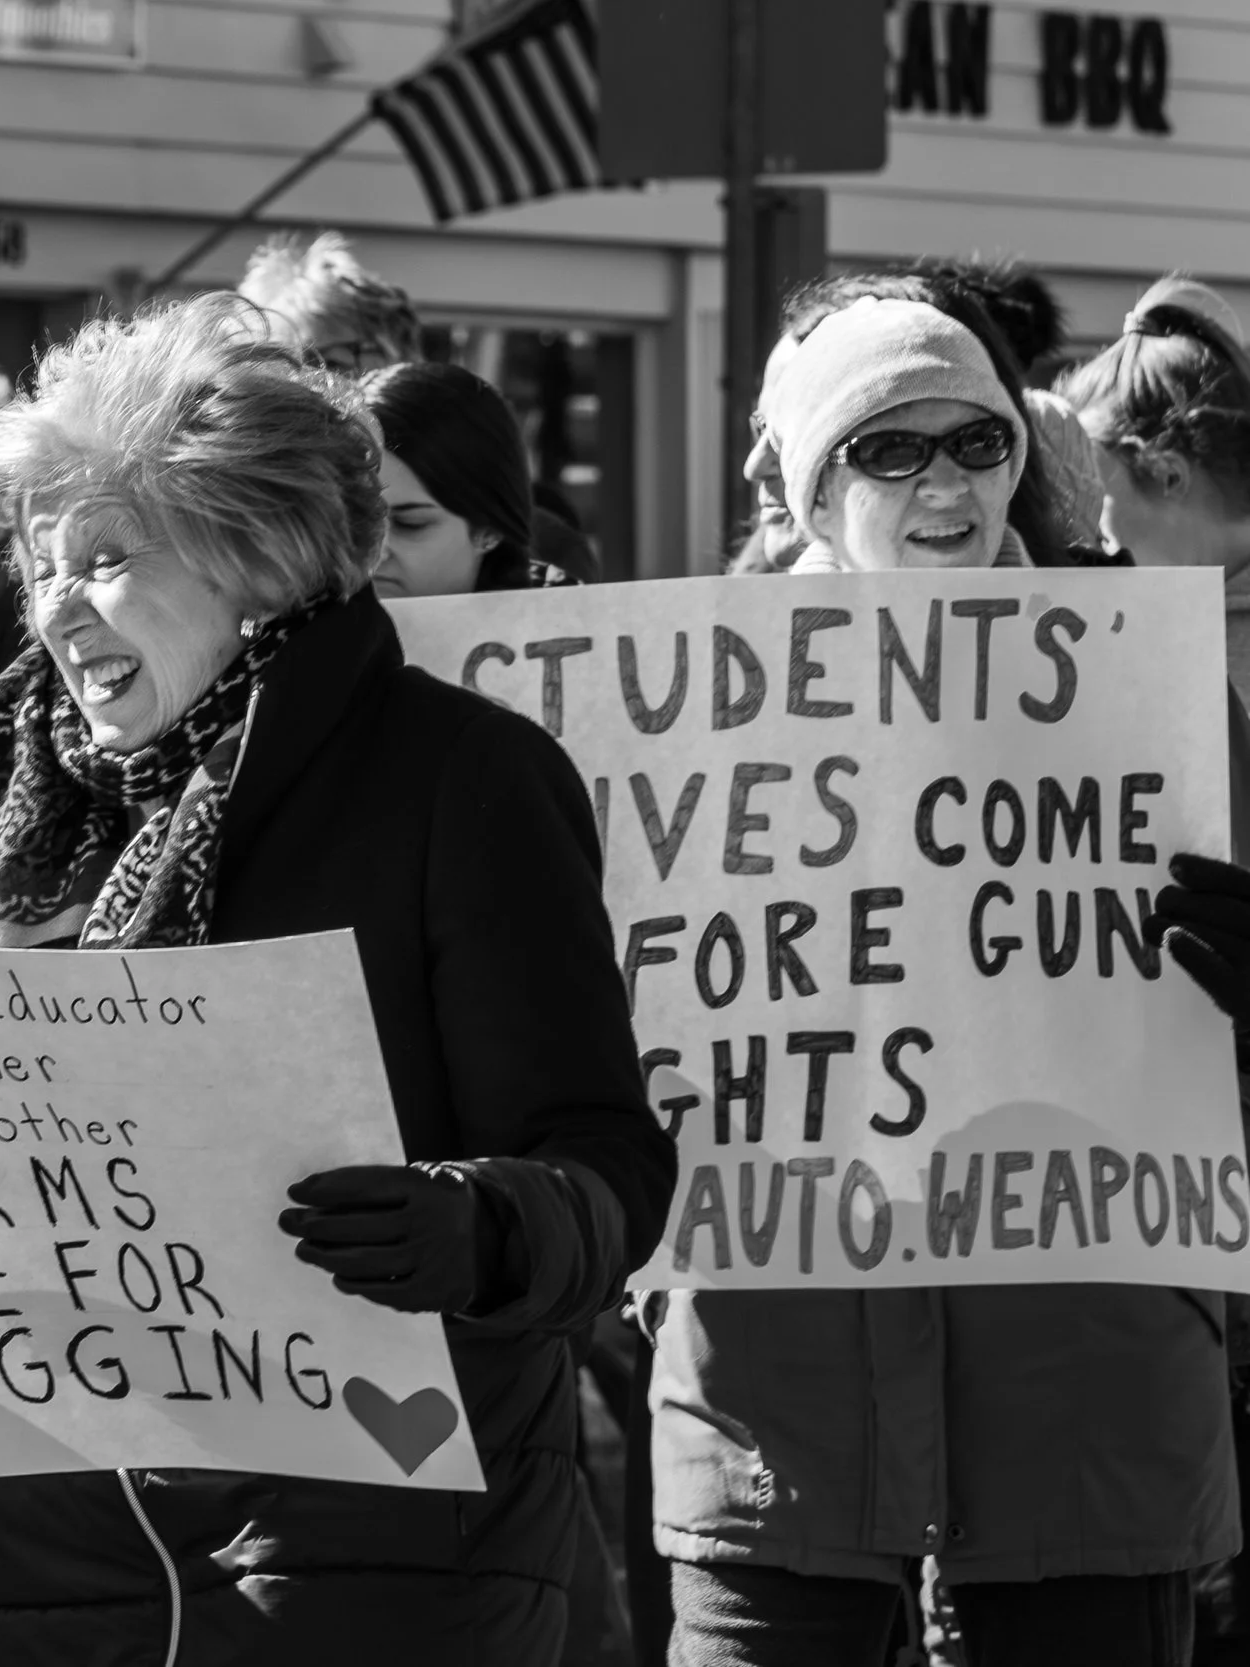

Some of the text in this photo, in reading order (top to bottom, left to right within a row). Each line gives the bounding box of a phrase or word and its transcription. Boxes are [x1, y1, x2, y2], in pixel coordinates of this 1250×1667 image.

[886, 0, 1173, 136] AN BBQ
[915, 773, 1165, 868] COME
[54, 1240, 225, 1319] FOR
